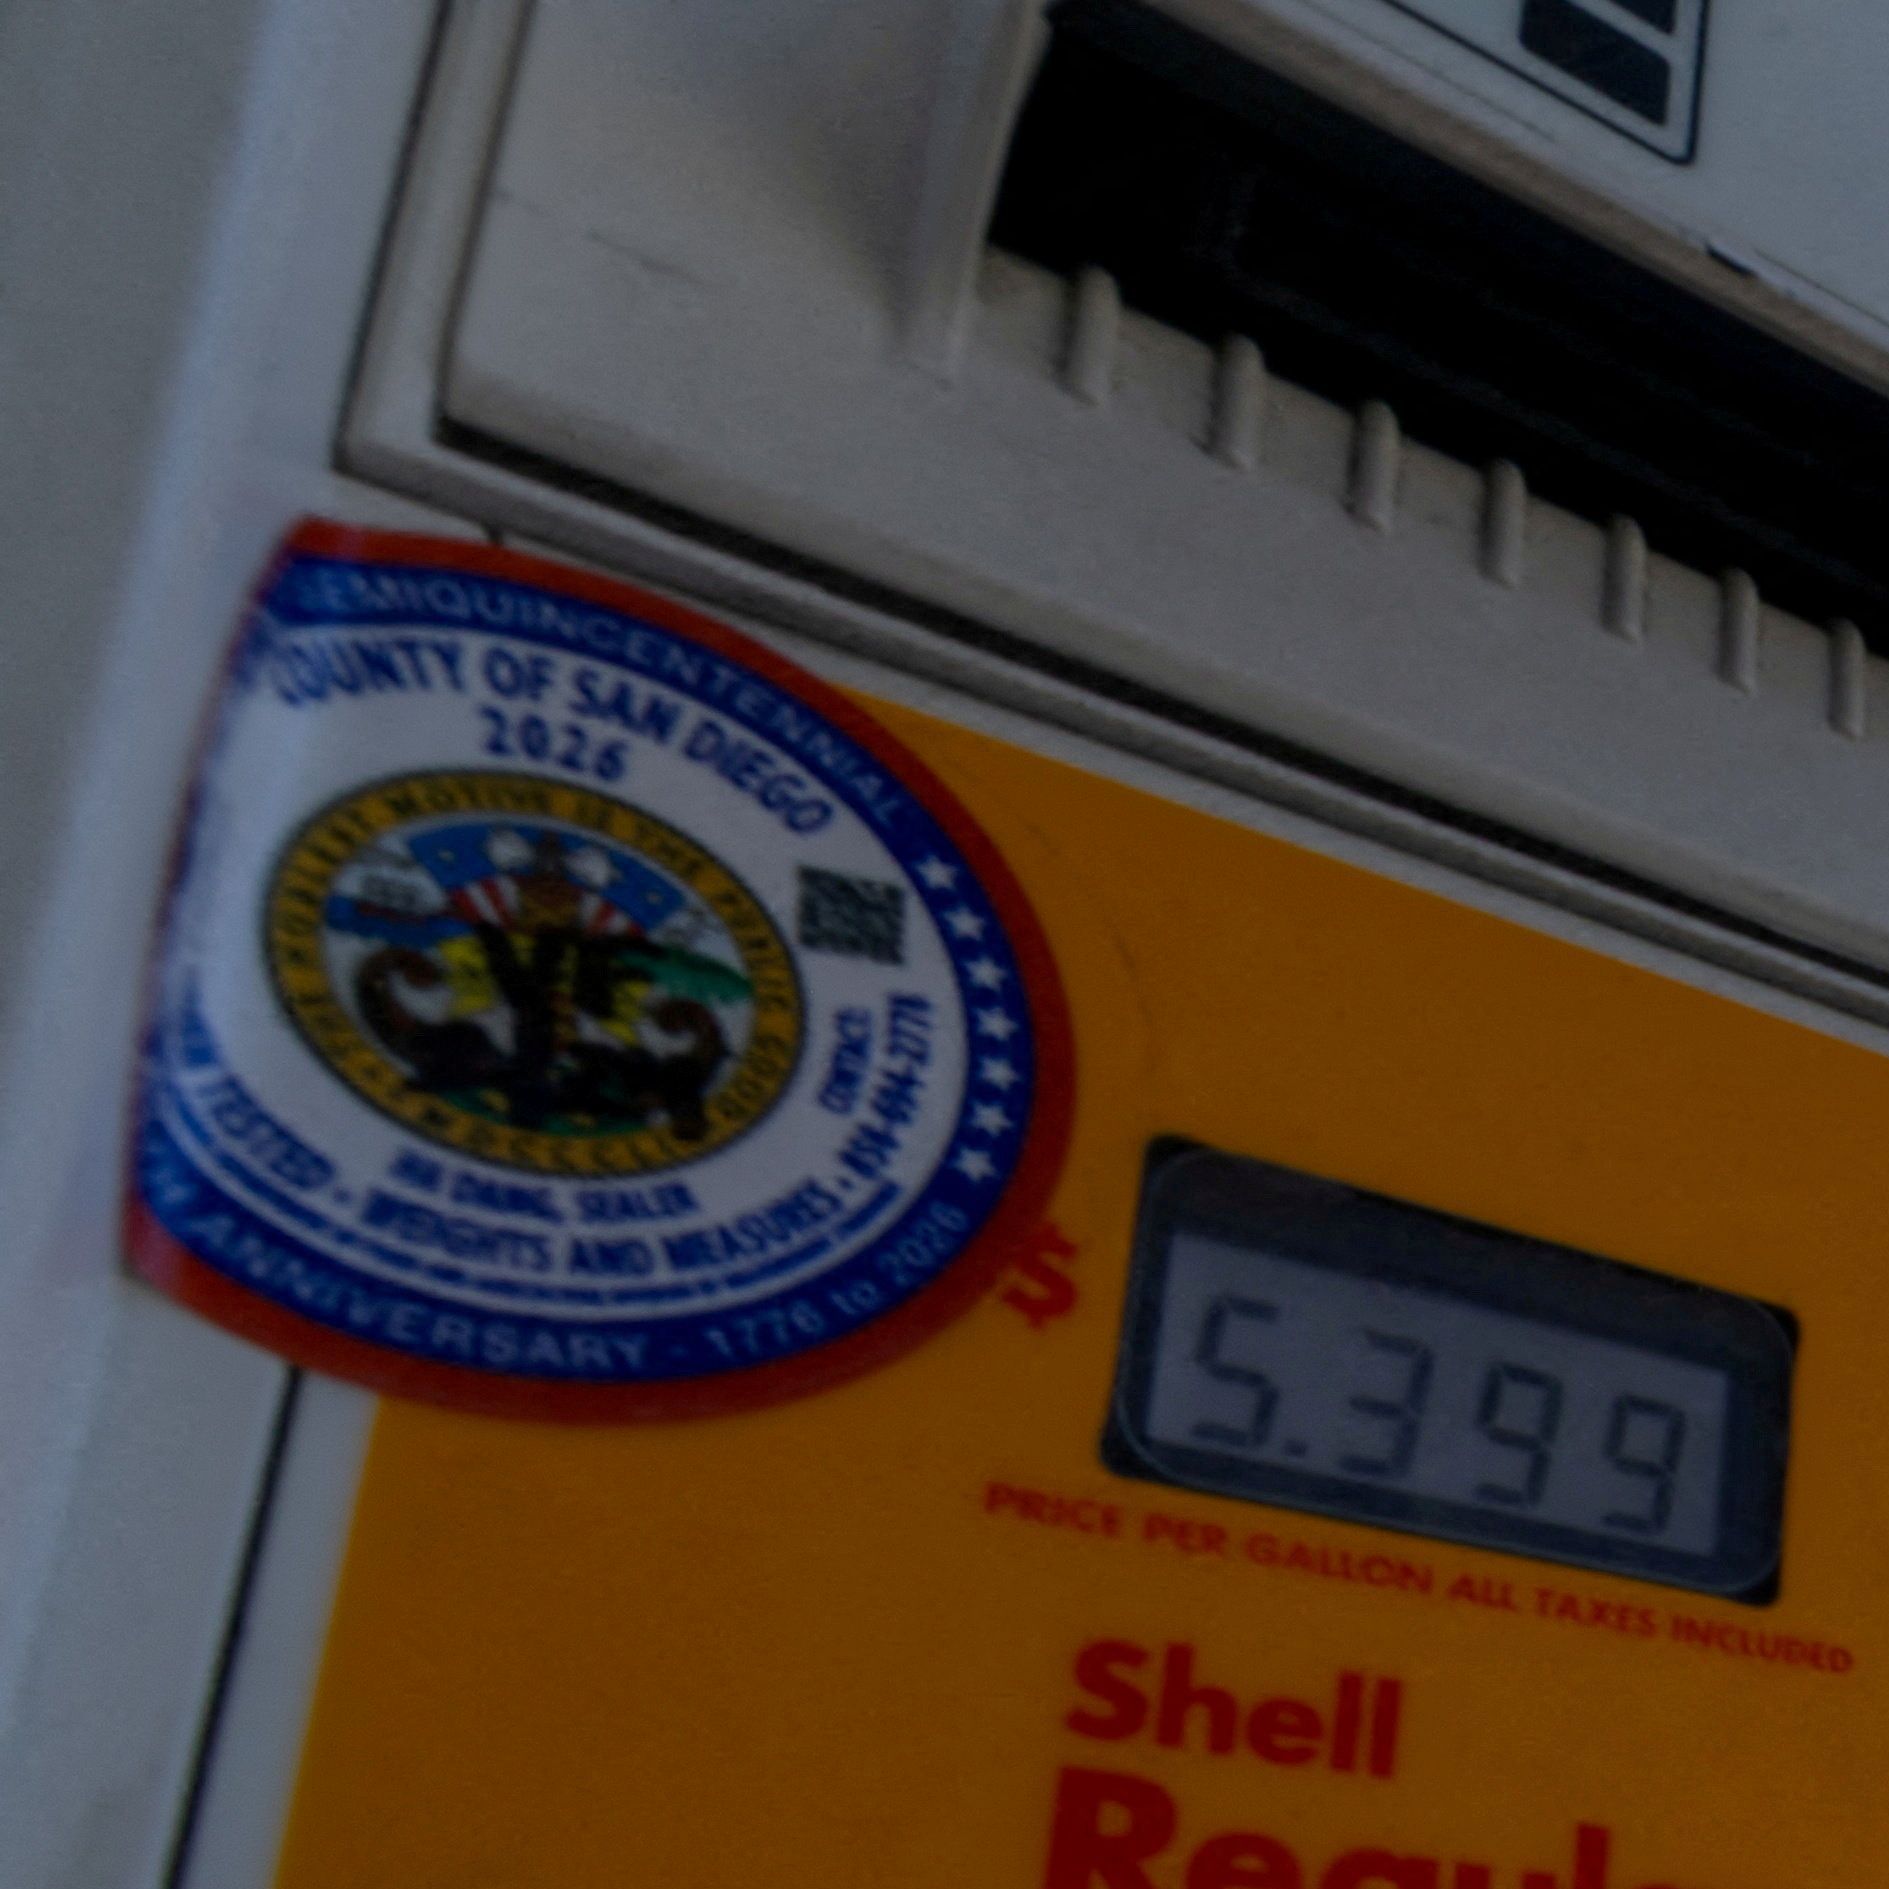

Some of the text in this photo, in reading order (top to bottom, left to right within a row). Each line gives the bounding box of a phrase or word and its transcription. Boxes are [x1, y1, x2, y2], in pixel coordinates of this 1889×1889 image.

[480, 708, 627, 783] 2026
[484, 650, 557, 704] OF
[569, 668, 675, 746] SAN
[684, 723, 833, 836] DIEGO
[1001, 1214, 1688, 1537] $ 5.399
[985, 1481, 1855, 1677] PRICE PER GALLON ALL TAXES INCLUDED
[1066, 1635, 1404, 1781] Shell
